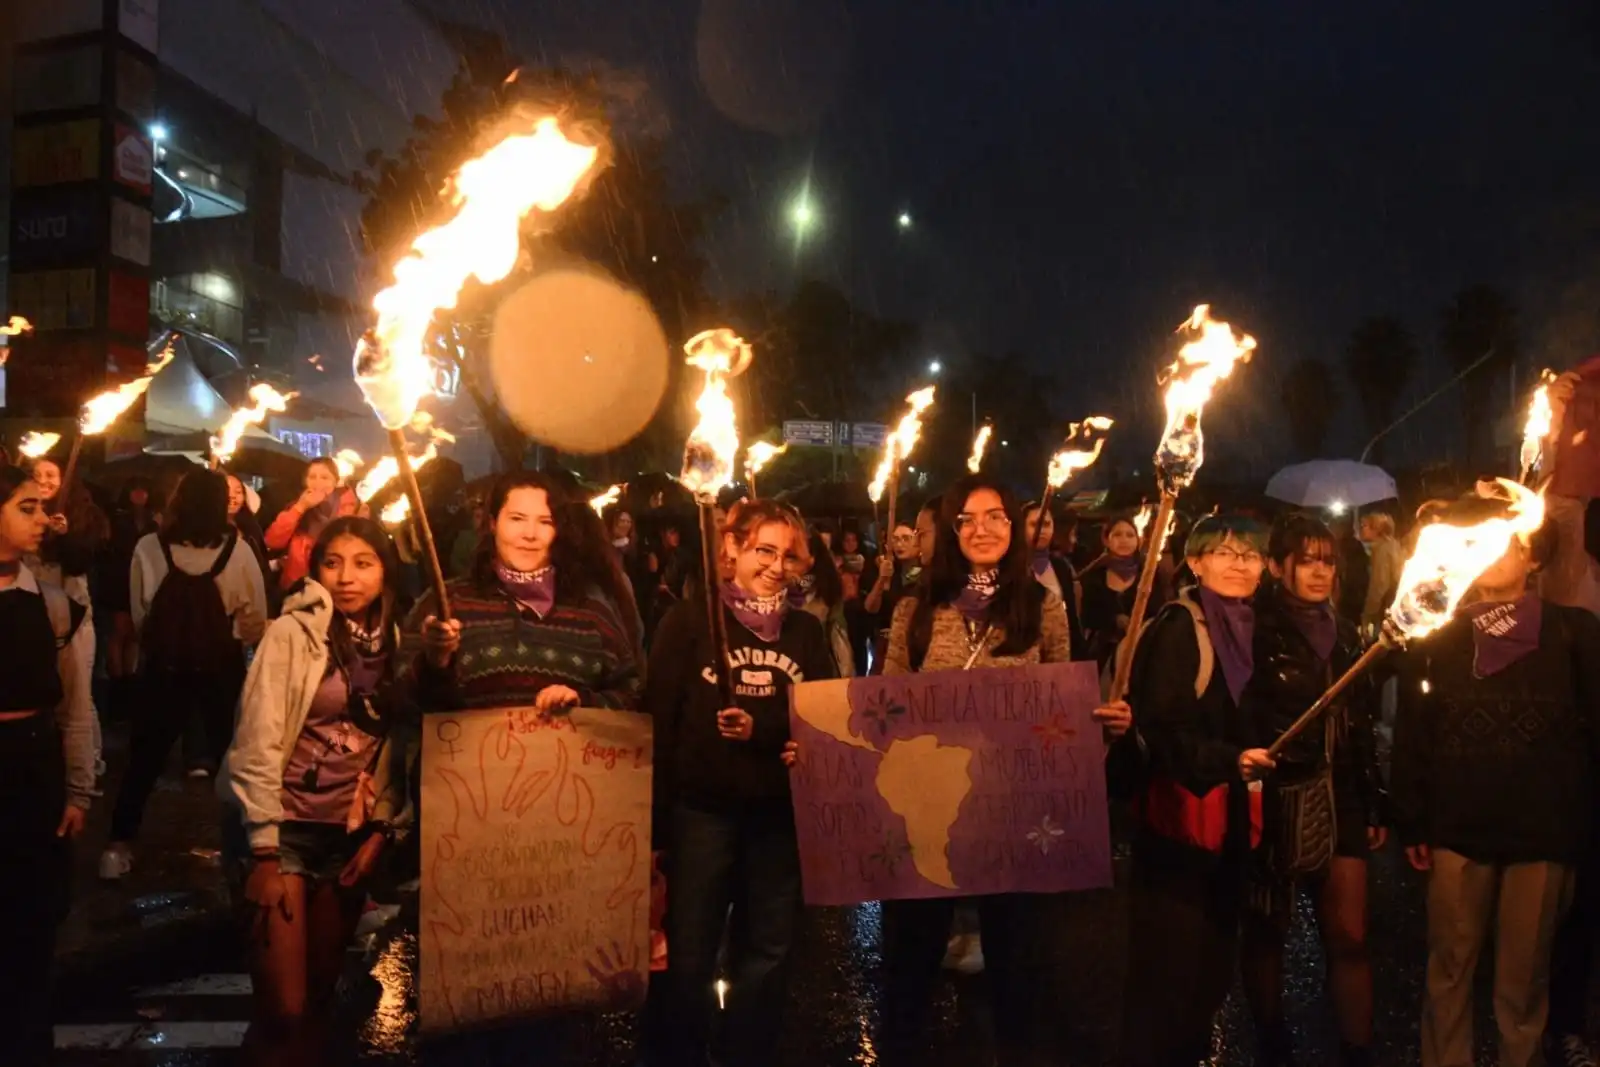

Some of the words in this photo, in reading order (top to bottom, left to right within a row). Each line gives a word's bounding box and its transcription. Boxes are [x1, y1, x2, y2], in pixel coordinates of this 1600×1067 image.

[906, 685, 943, 724] NI
[953, 684, 980, 724] LA
[481, 901, 565, 939] LUCHAN
